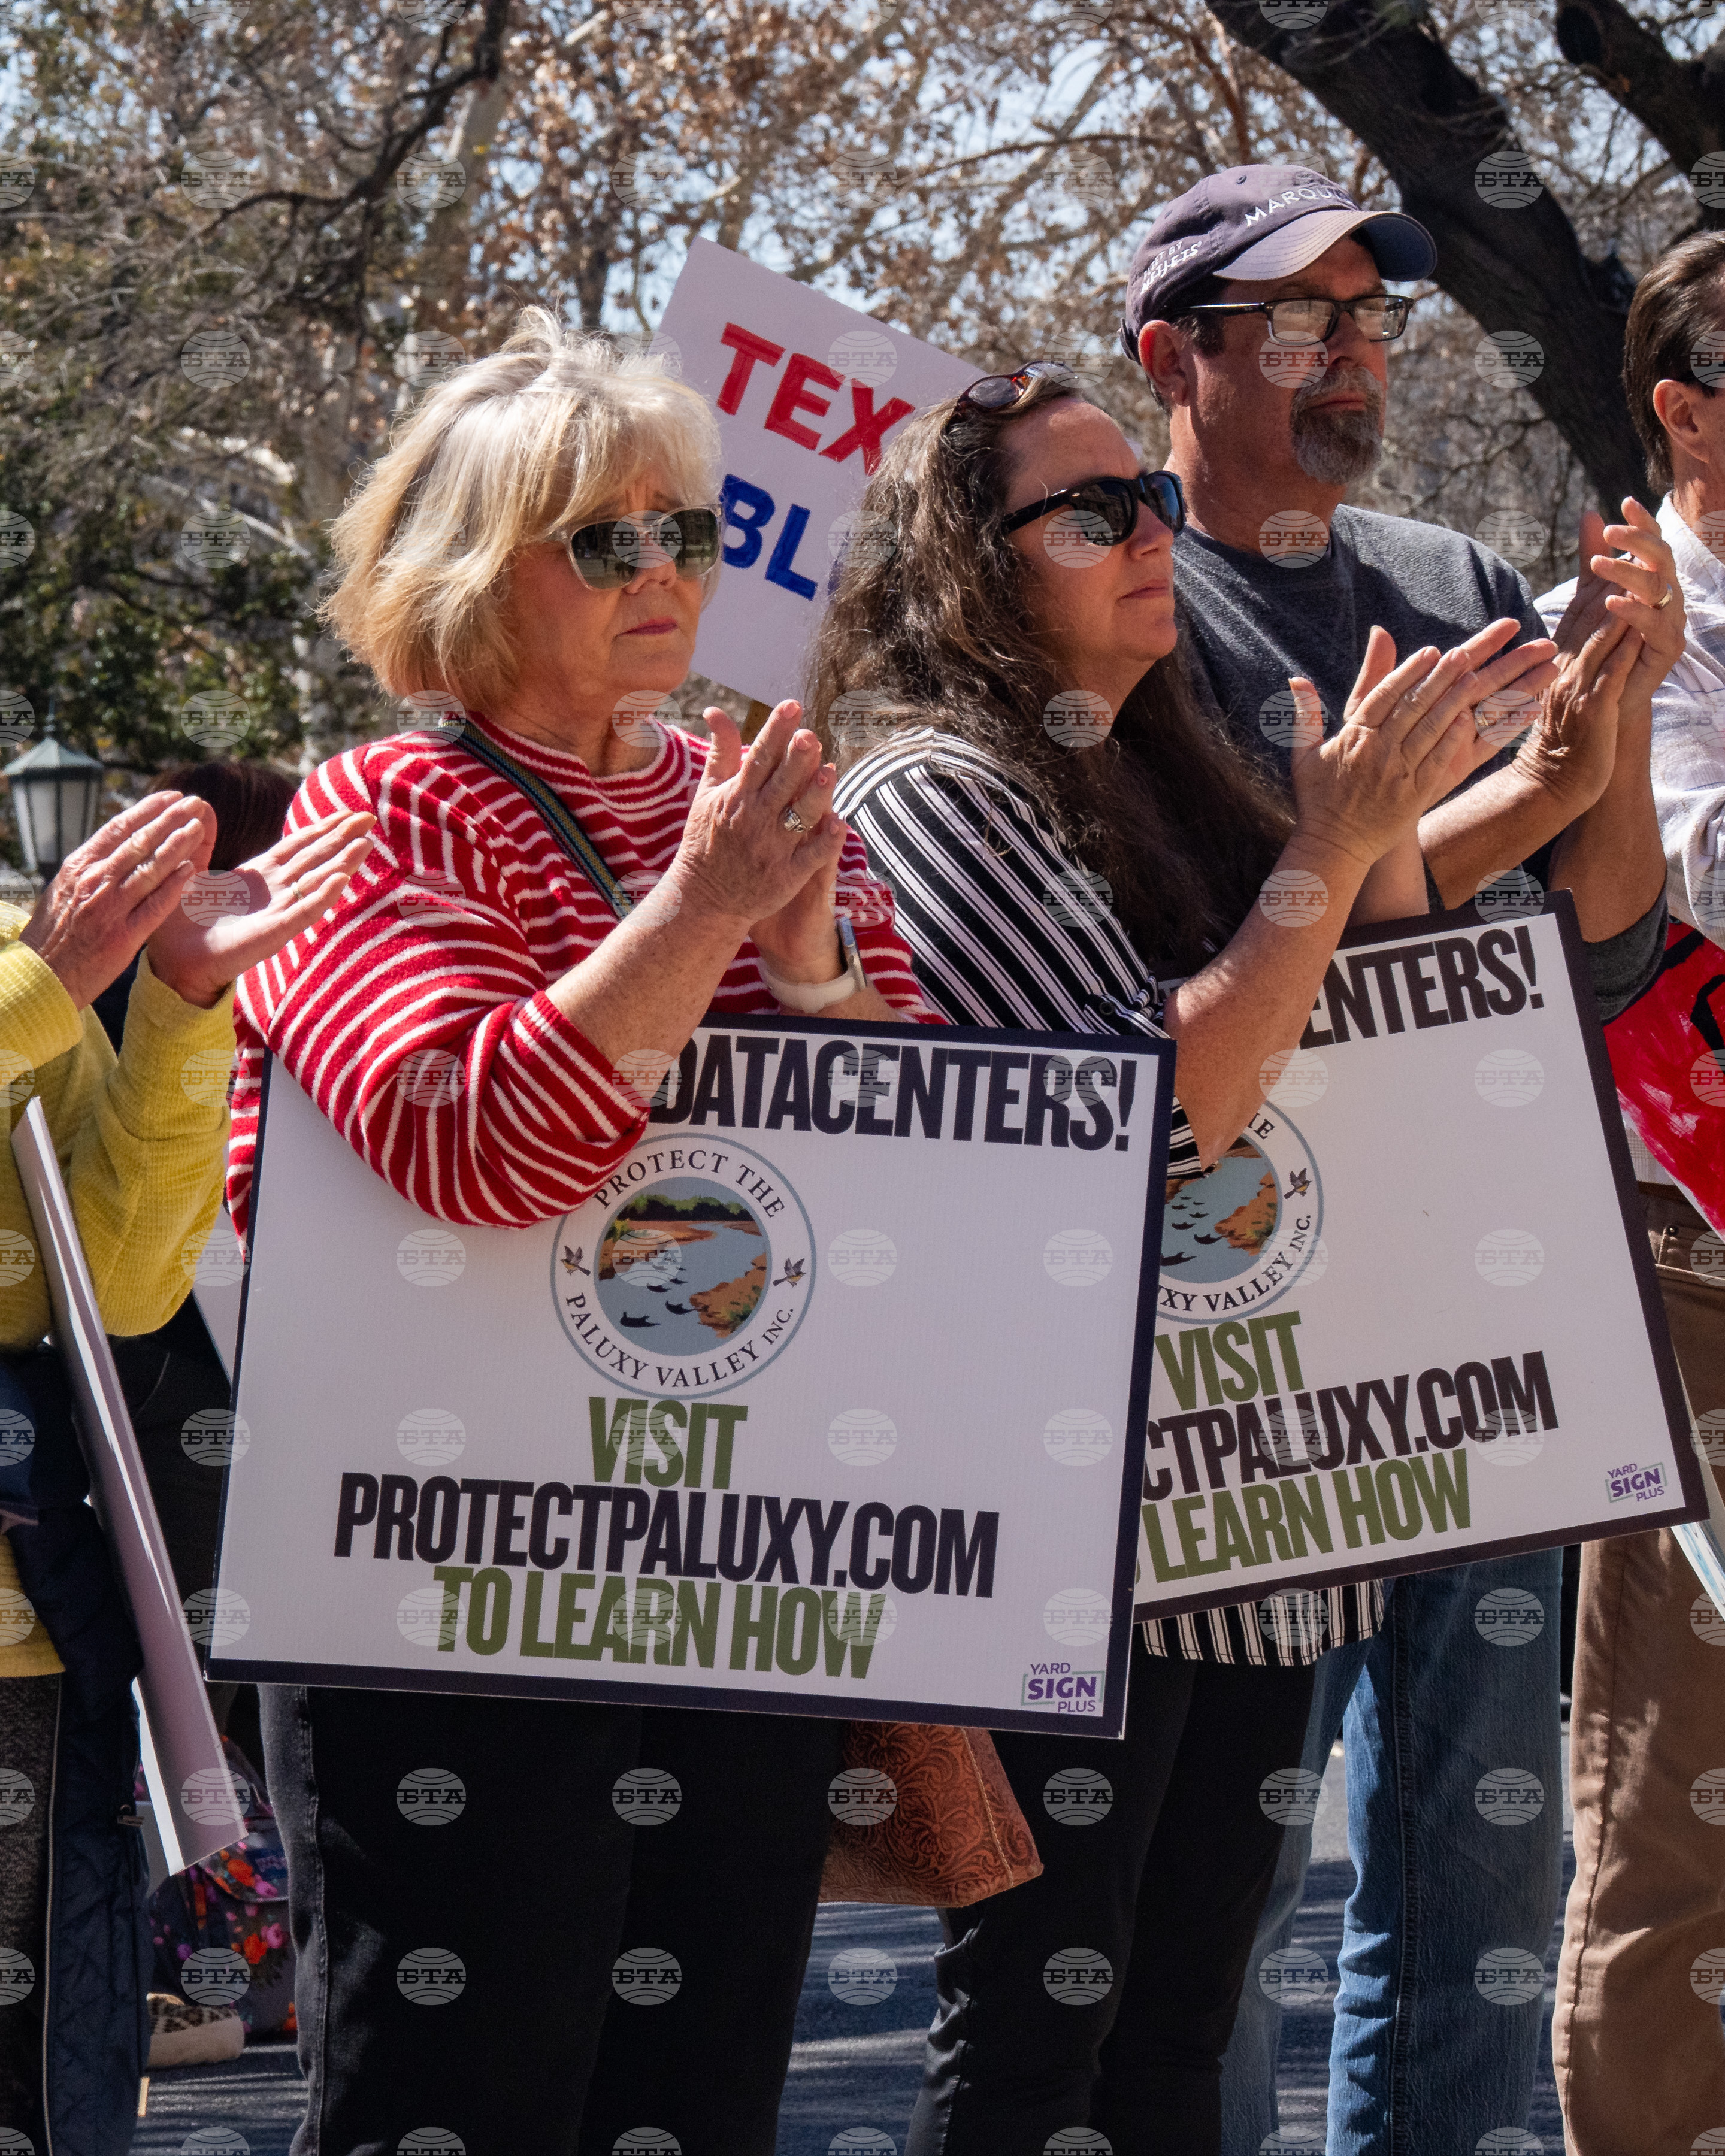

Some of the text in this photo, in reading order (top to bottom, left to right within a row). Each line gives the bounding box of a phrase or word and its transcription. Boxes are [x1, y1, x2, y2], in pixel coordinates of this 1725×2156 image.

[1169, 241, 1183, 255] BY
[649, 1034, 1137, 1152] DATACENTERS!
[593, 1149, 785, 1218] PROTECT THE
[1203, 1251, 1294, 1312] VALLEY
[1288, 1214, 1311, 1252] INC.
[566, 1292, 794, 1388] PALUXY VALLEY INC.
[1154, 1310, 1305, 1411] VISIT
[588, 1397, 749, 1489] VISIT
[1608, 1463, 1638, 1479] YARD
[1610, 1468, 1662, 1498] SIGN
[1142, 1448, 1472, 1583] LEARN HOW
[1636, 1486, 1665, 1502] PLUS
[334, 1472, 1000, 1598] PROTECTPALUXY.COM
[434, 1565, 887, 1679] TO LEARN HOW
[1028, 1676, 1097, 1700] SIGN
[1030, 1662, 1072, 1675] YARD
[1057, 1700, 1096, 1713] PLUS
